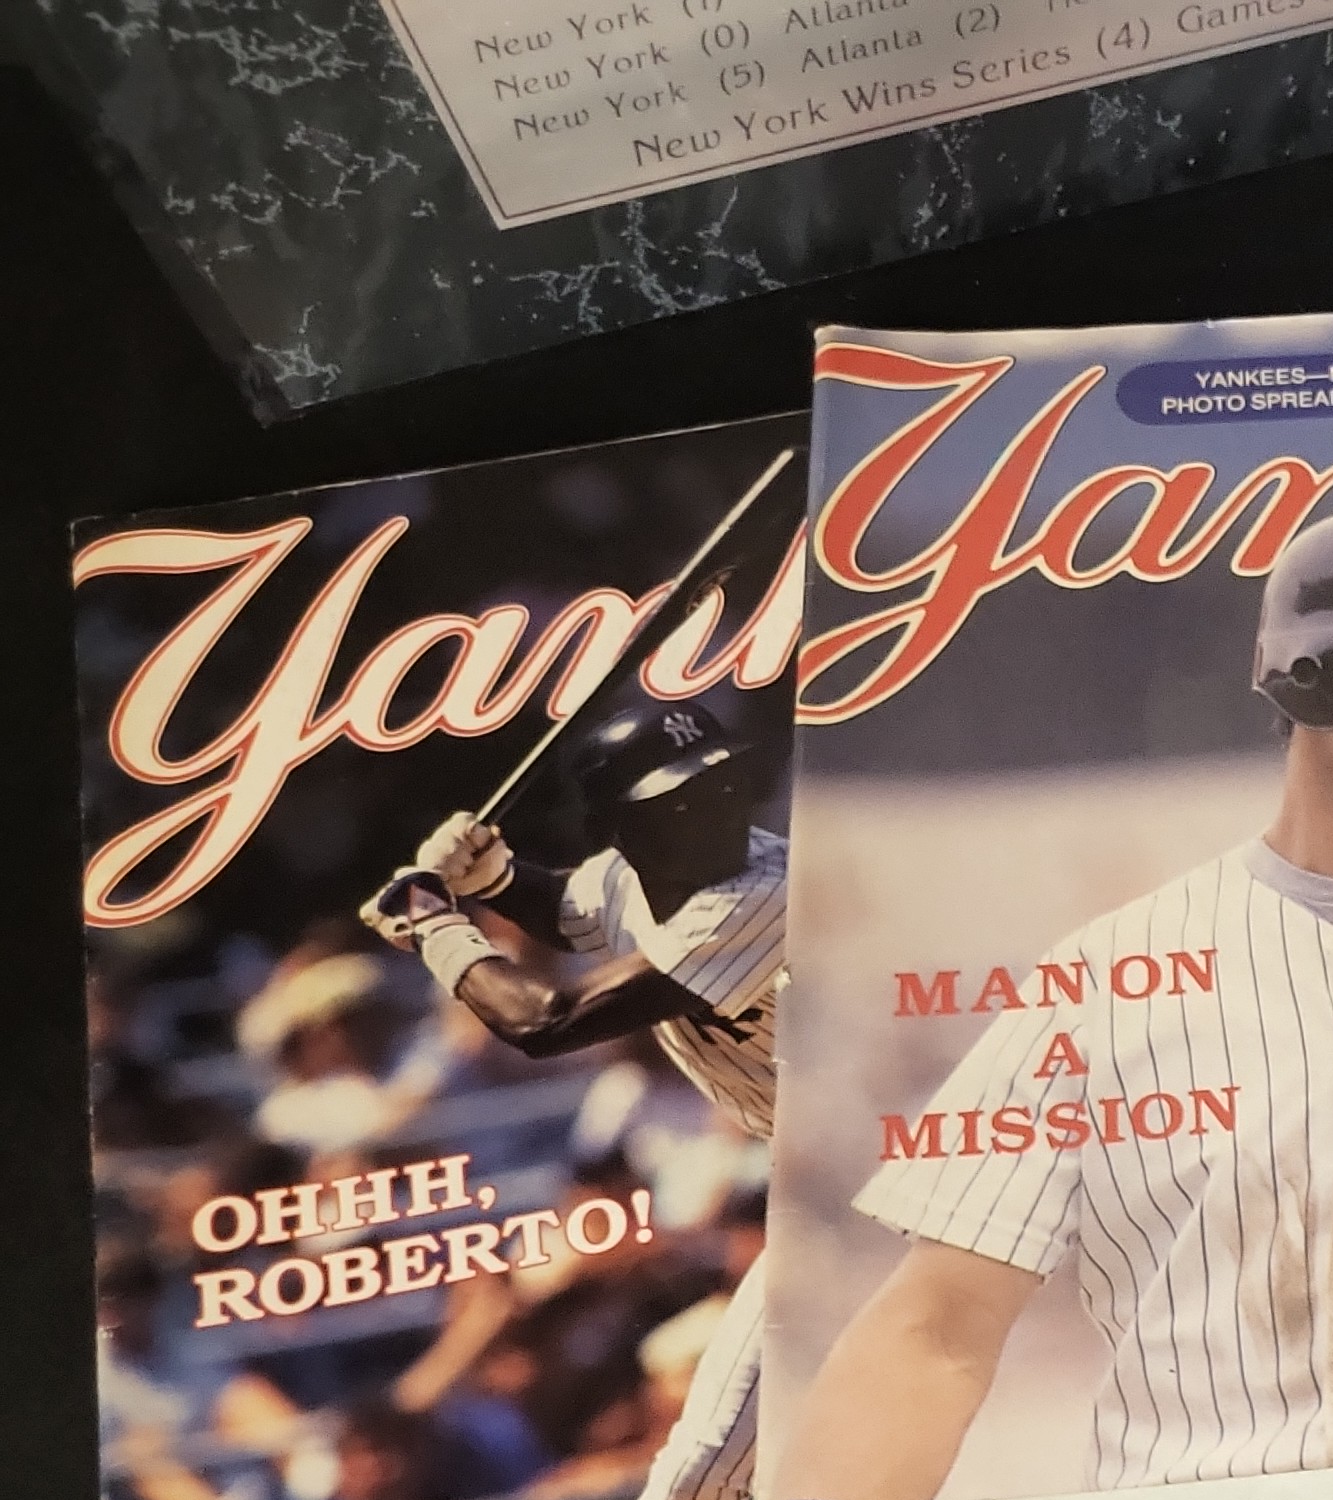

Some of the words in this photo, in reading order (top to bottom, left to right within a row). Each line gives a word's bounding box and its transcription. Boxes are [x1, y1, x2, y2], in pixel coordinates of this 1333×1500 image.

[474, 30, 552, 63] New
[568, 3, 653, 41] York
[494, 67, 570, 101] New
[586, 43, 671, 79] York
[701, 20, 750, 56] (0)
[512, 107, 590, 142] New
[604, 81, 691, 118] York
[719, 60, 766, 96] (5)
[800, 27, 922, 74] Atlanta
[954, 3, 1001, 40] (2)
[632, 126, 721, 168] New
[733, 98, 830, 142] York
[841, 74, 937, 116] Wins
[952, 40, 1071, 90] Series
[1096, 16, 1151, 60] (4)
[1162, 394, 1245, 415] PHOTO
[72, 516, 807, 928] Yan
[894, 962, 1084, 1017] MAN
[1111, 949, 1218, 1001] ON
[1034, 1031, 1089, 1078] A
[879, 1086, 1240, 1161] MISSION
[192, 1155, 496, 1253] OHHH,
[194, 1189, 655, 1329] ROBERTO!
